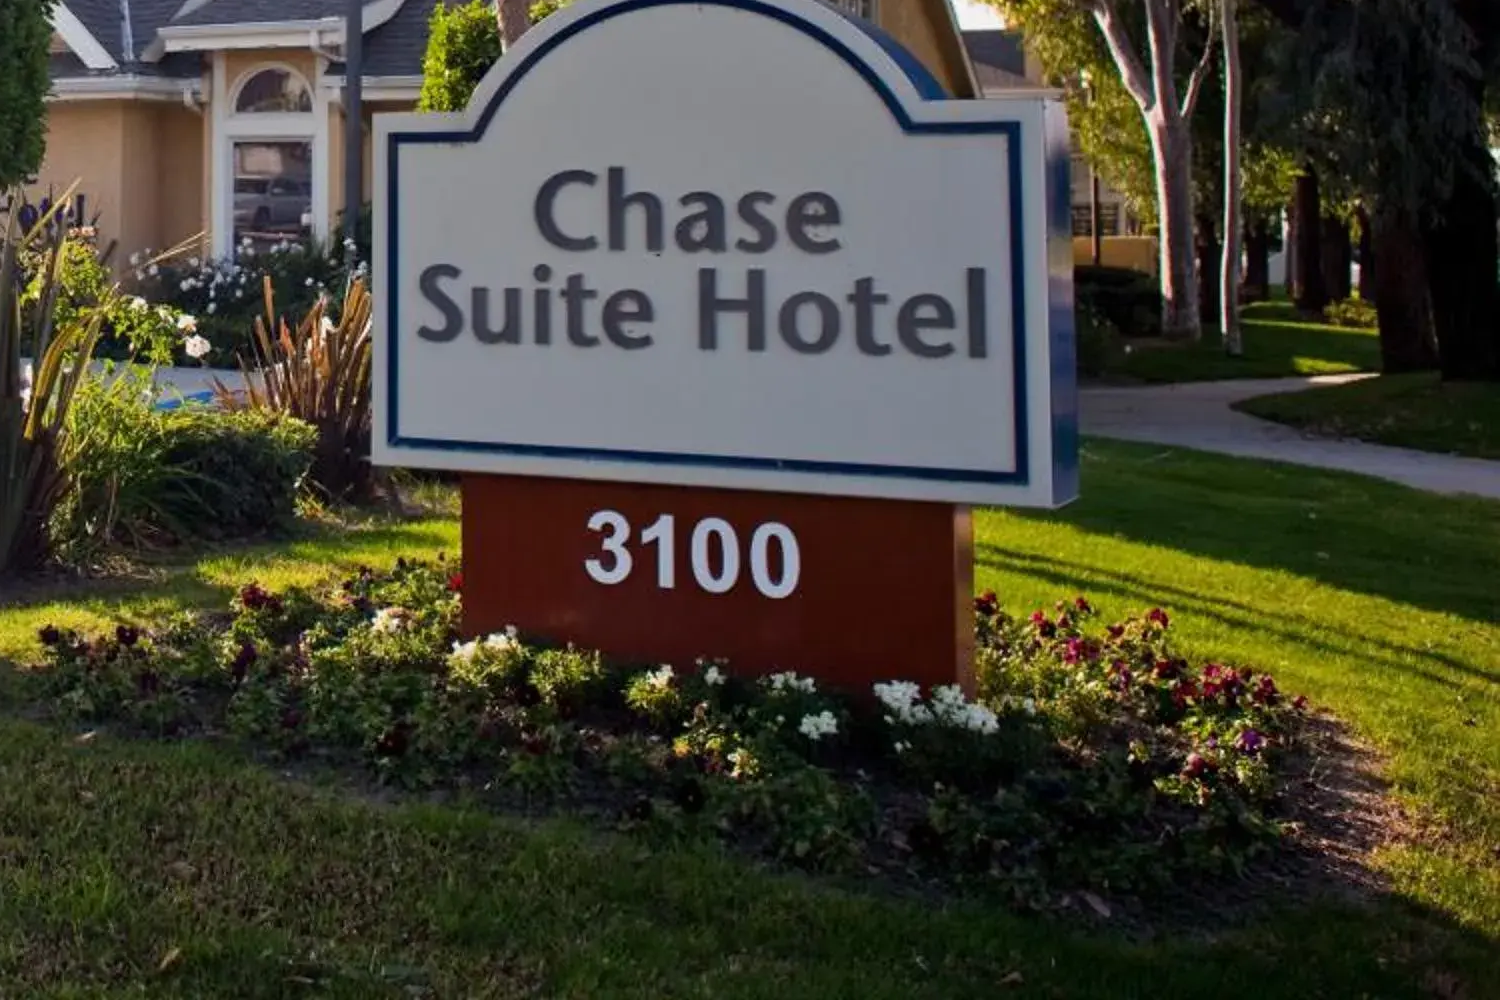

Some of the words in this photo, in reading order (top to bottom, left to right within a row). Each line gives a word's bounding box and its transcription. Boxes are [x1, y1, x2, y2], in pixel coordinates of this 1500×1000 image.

[533, 165, 842, 255] Chase
[416, 263, 655, 351] Suite
[698, 267, 989, 360] Hotel
[585, 510, 801, 599] 3100
